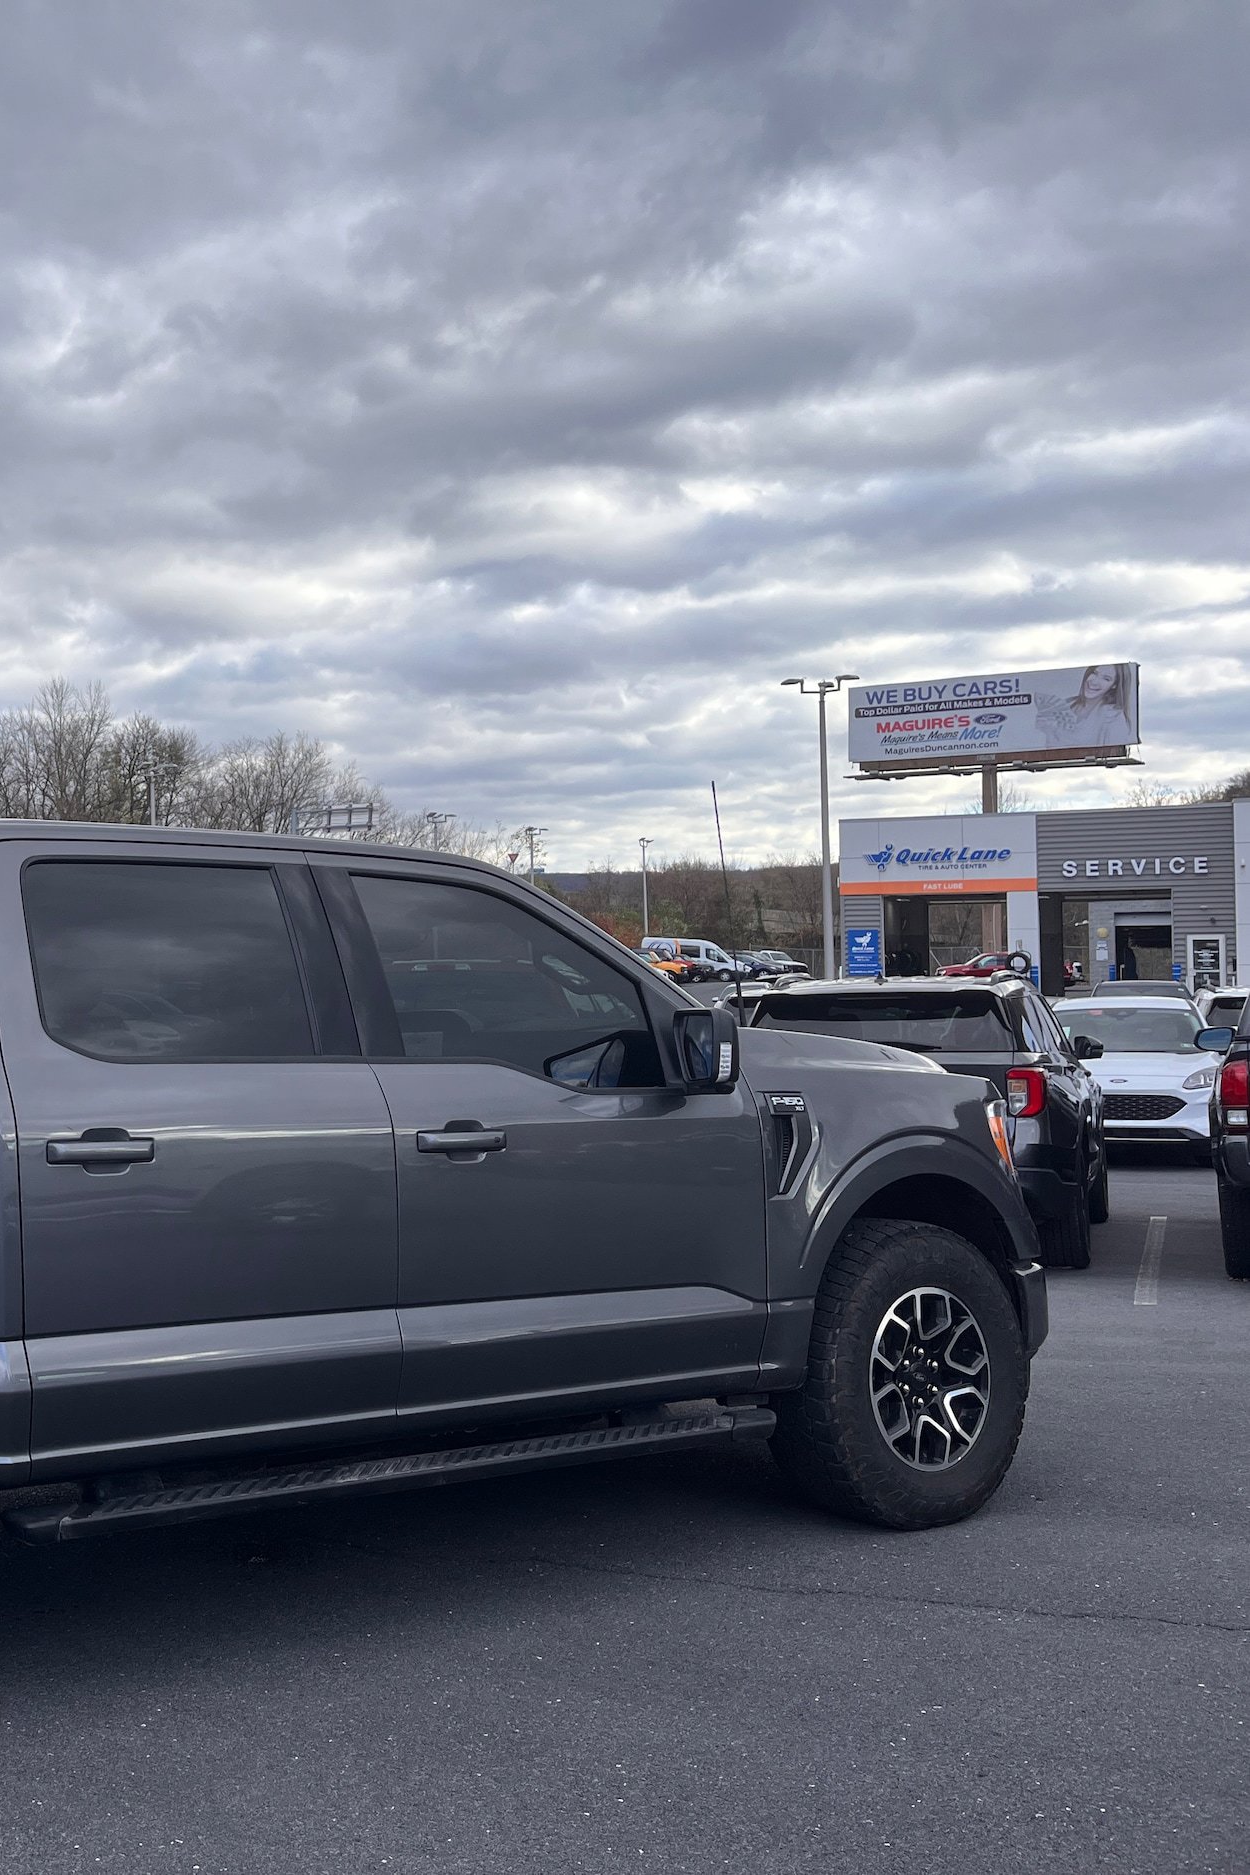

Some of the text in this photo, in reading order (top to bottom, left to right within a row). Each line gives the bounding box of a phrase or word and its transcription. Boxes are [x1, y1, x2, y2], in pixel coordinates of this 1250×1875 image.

[865, 678, 1020, 705] WE BUY CARS!
[859, 696, 1029, 717] Top Dollar Paid for All Makes & Models
[876, 714, 971, 733] MAGUIRE'S
[978, 713, 1003, 725] Ford
[880, 725, 1003, 746] Maguire's Means More!
[884, 741, 999, 756] MaguiresDuncannon.com
[895, 847, 1012, 865] Quick Lane
[1062, 856, 1209, 878] SERVICE
[943, 882, 964, 890] LUBE
[771, 1096, 805, 1106] F-150
